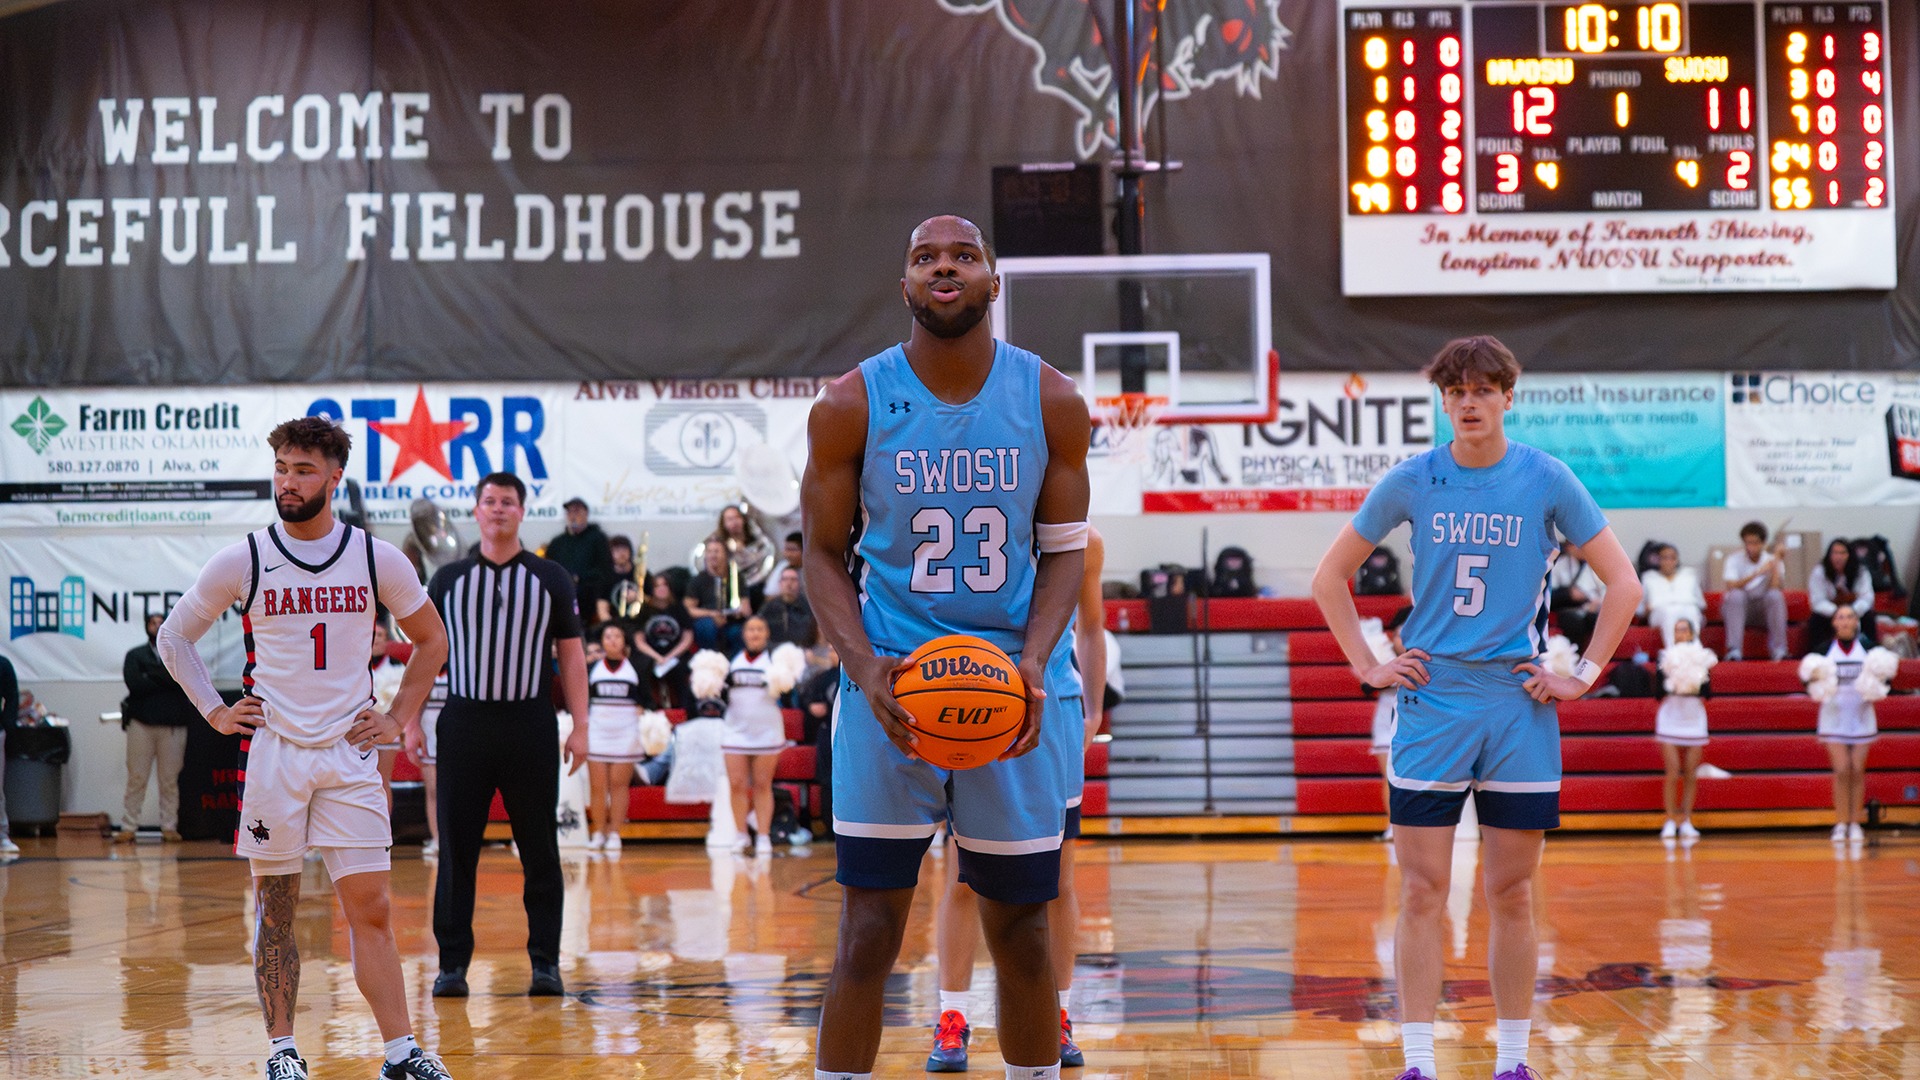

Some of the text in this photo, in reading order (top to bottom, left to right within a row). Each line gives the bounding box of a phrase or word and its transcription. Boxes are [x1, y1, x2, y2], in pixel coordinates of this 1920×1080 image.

[1564, 3, 1681, 53] 10:10
[1403, 40, 1415, 65] 1
[1786, 31, 1880, 64] 2 1 3
[1589, 71, 1642, 87] PERIOD
[1664, 56, 1729, 83] SWOSU
[1789, 68, 1881, 100] 3 0 4
[1403, 76, 1415, 102] 1
[1513, 86, 1555, 135] 12
[1615, 91, 1630, 128] 1
[1708, 87, 1751, 130] 11
[1817, 104, 1836, 135] 0
[1863, 104, 1882, 134] 0
[98, 91, 573, 165] WELCOME TO
[1366, 109, 1389, 142] 5
[1440, 109, 1462, 141] 2
[1476, 137, 1523, 153] FOULS
[1567, 135, 1668, 153] PLAYER FOUL
[1708, 135, 1755, 150] FOULS
[1771, 140, 1883, 173] 24 0 2
[1441, 145, 1463, 176] 2
[1497, 153, 1519, 193] 3
[1534, 161, 1559, 190] 4
[1676, 160, 1700, 188] 4
[1727, 150, 1751, 190] 2
[1405, 185, 1417, 211] 1
[1441, 182, 1463, 212] 6
[1478, 192, 1525, 210] SCORE
[1593, 191, 1642, 208] MATCH
[1709, 190, 1756, 208] SCORE
[1772, 177, 1884, 209] 55 1 2
[346, 190, 802, 264] FIELDHOUSE
[1420, 219, 1815, 250] In Memory of Kenneth Thiesing,
[1440, 247, 1794, 277] longtime NWOSU Supporter.
[574, 377, 822, 401] Alva Vision Clini
[1594, 383, 1716, 403] Insurance
[1765, 375, 1876, 404] Choice
[79, 401, 241, 432] Farm Credit
[59, 432, 261, 452] WESTERN OKLAHOMA
[48, 459, 220, 474] 580.327.0870 Alva, OK
[895, 447, 1021, 494] SWOSU
[1241, 455, 1416, 474] PHYSICAL THERA
[56, 508, 213, 524] farmcreditloans.com
[1432, 511, 1524, 548] SWOSU
[909, 506, 1008, 593] 23
[1453, 553, 1490, 618] 5
[263, 585, 369, 617] RANGERS
[310, 622, 327, 670] 1
[920, 655, 1010, 685] Wilson
[938, 706, 993, 725] EVO
